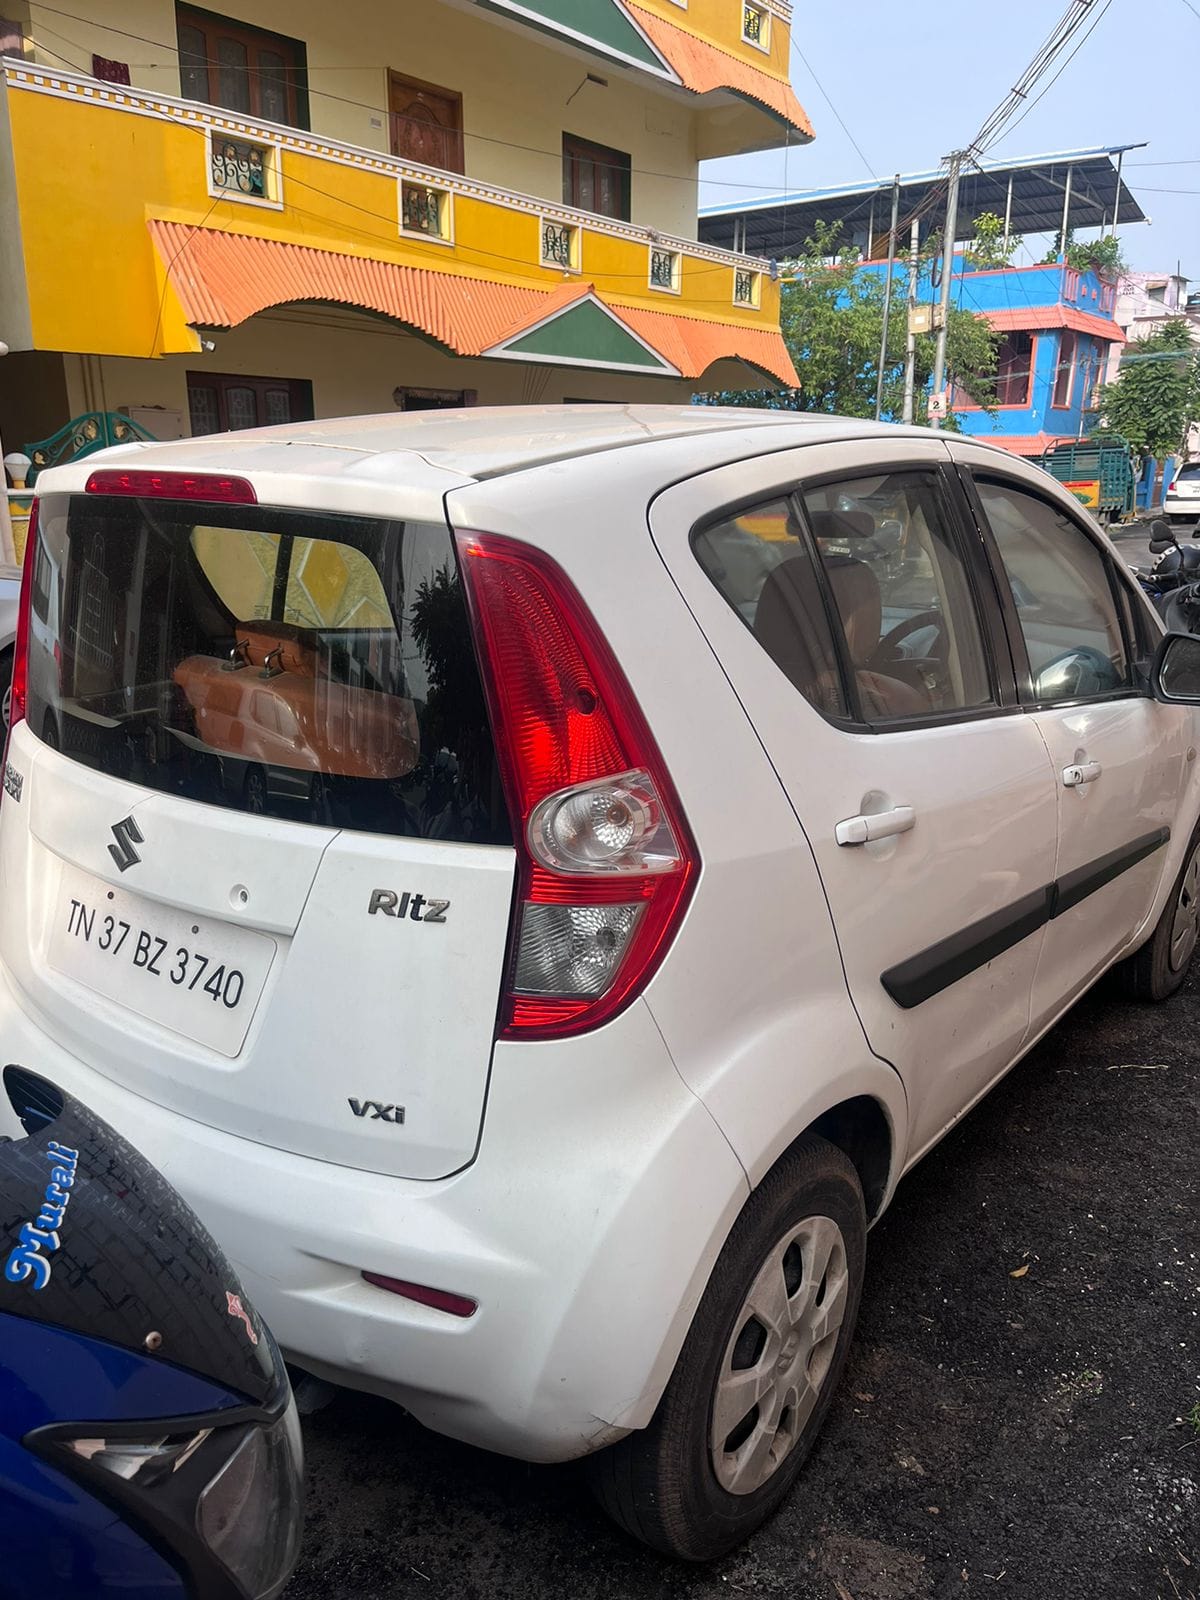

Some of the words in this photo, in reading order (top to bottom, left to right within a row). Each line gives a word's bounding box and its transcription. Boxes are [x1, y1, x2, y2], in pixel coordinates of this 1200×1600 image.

[933, 401, 940, 409] 2
[67, 899, 96, 942] TN
[98, 916, 131, 955] 37
[133, 930, 168, 976] BZ
[170, 948, 244, 1009] 3740
[5, 1141, 79, 1291] Murali
